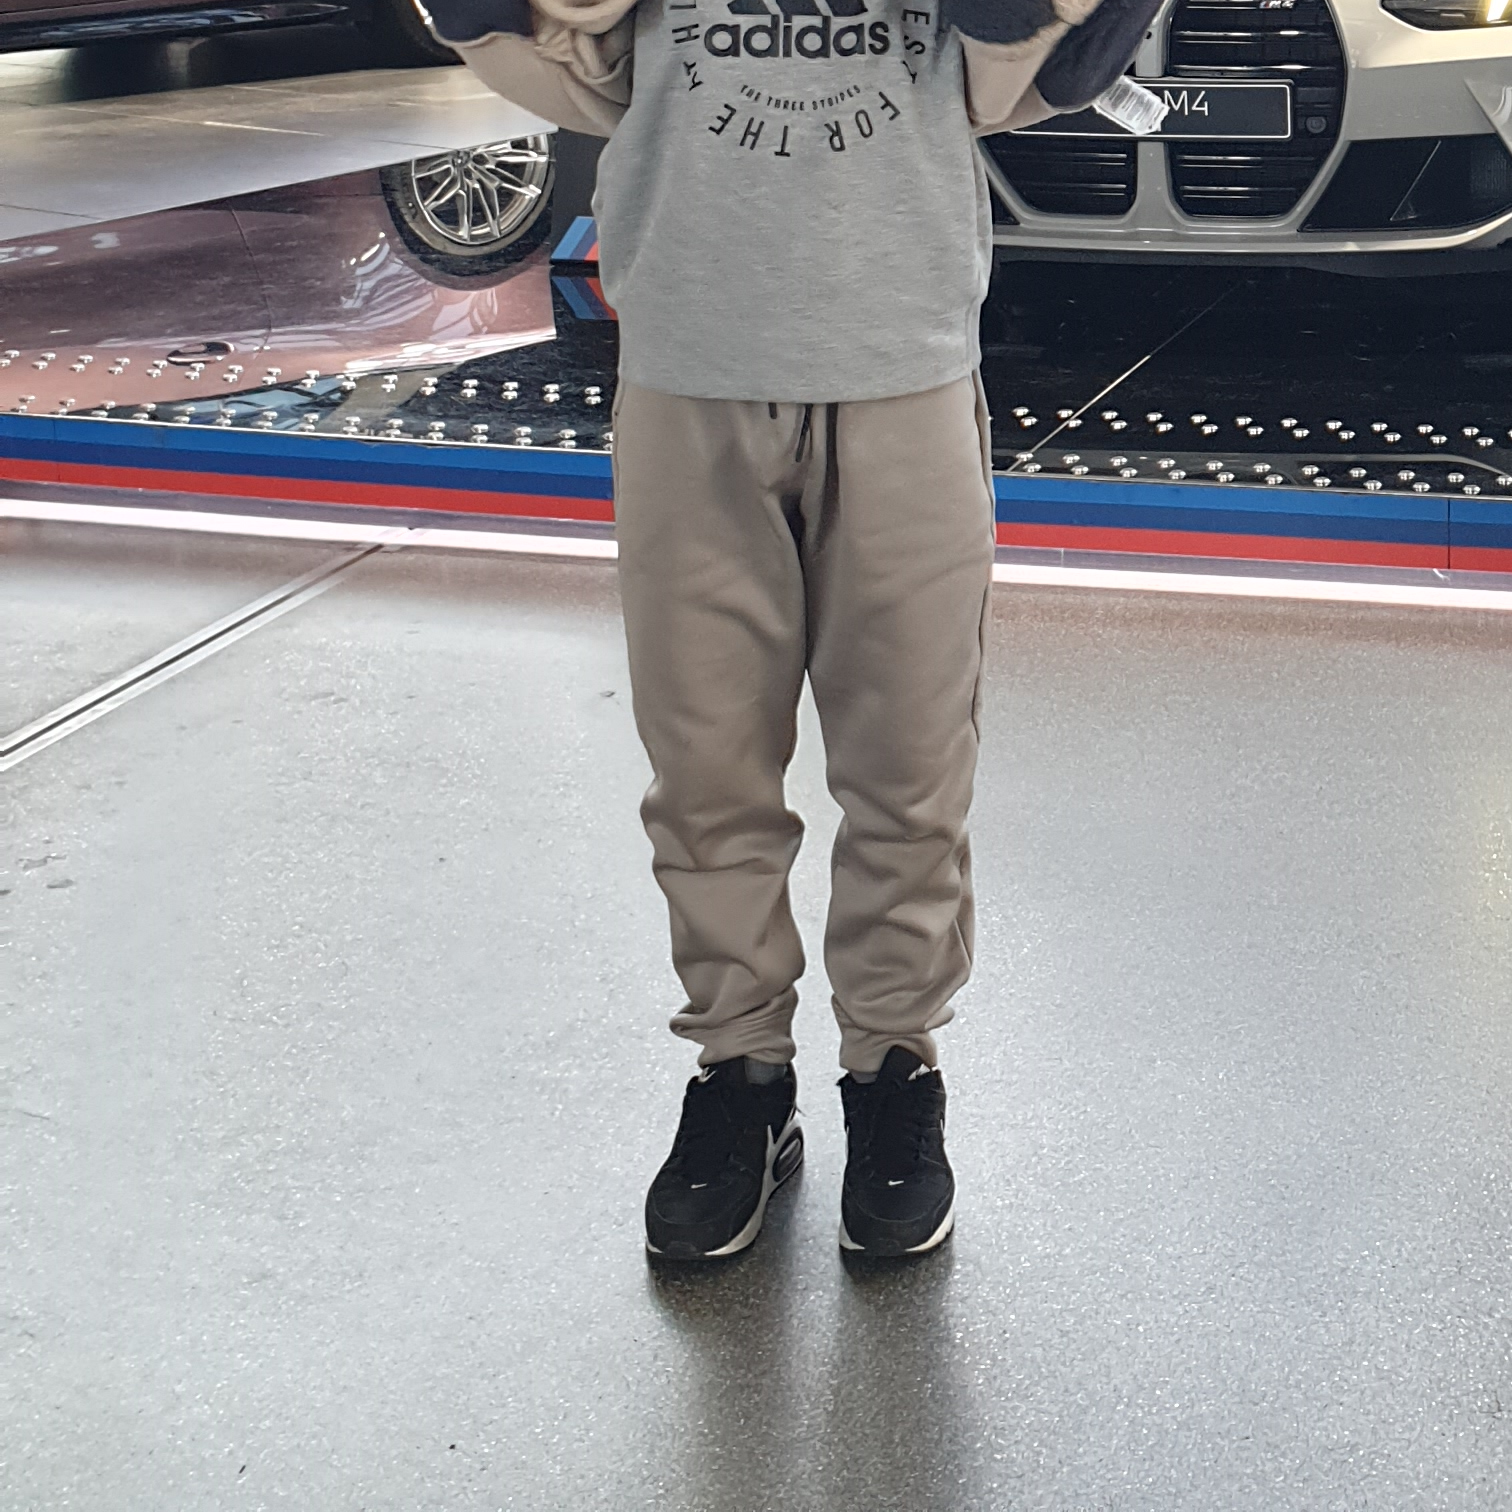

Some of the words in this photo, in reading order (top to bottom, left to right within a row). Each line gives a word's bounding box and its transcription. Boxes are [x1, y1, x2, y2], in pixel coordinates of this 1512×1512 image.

[703, 14, 891, 59] adidas
[823, 91, 901, 153] FOR
[1163, 90, 1209, 116] M4
[708, 102, 792, 157] THE
